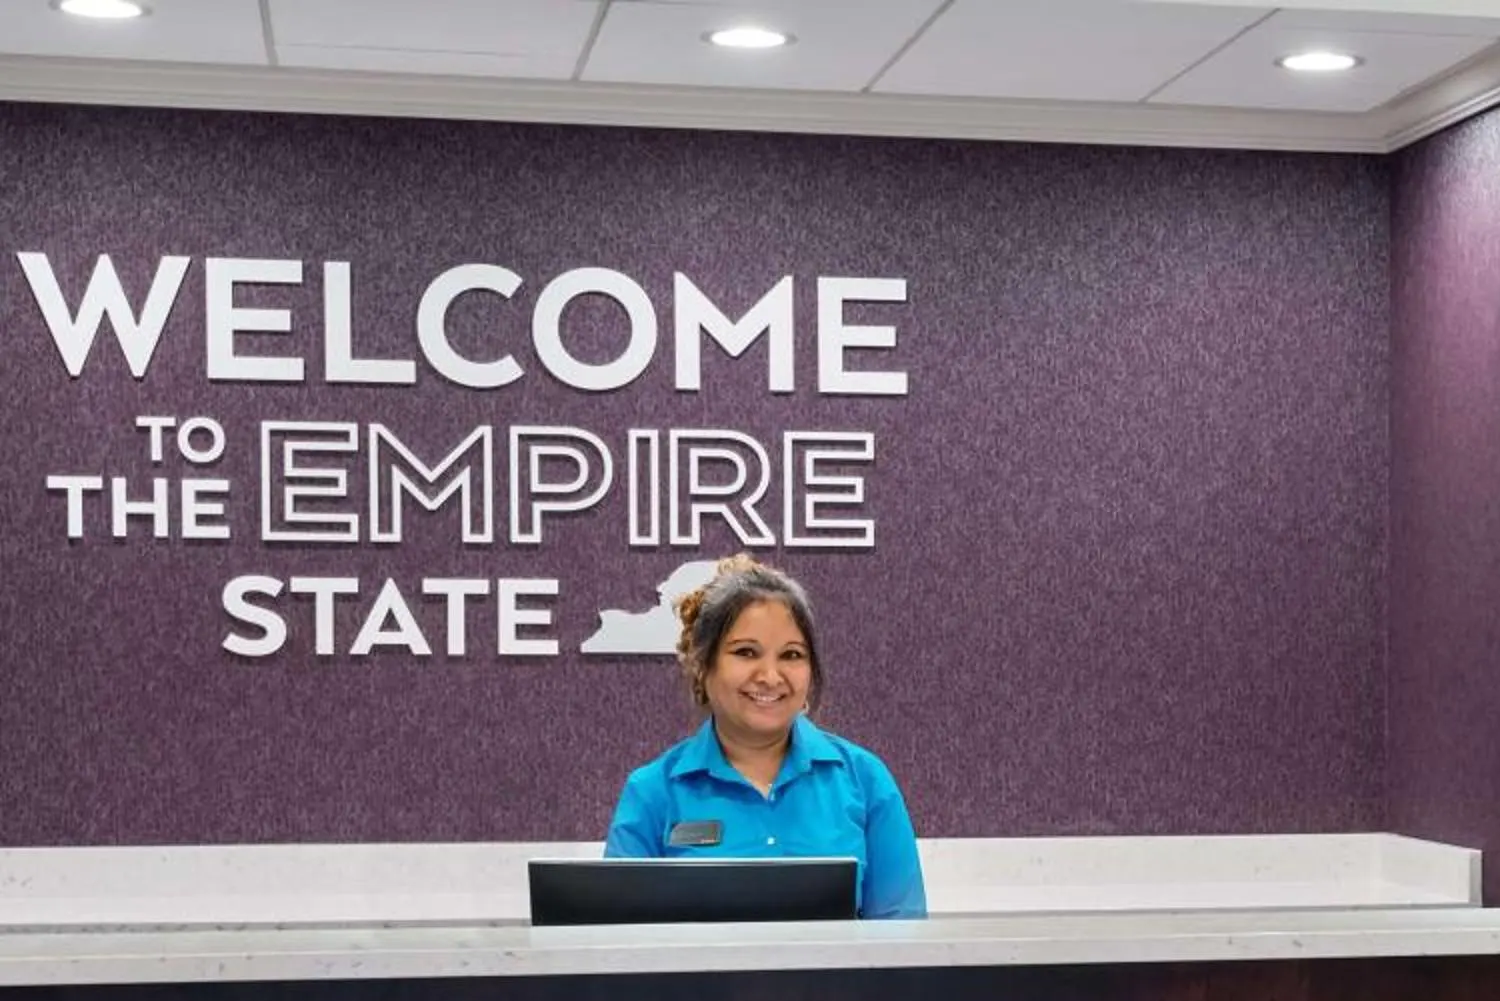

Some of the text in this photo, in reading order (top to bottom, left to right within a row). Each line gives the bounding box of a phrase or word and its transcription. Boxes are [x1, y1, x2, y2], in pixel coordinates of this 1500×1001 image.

[16, 251, 909, 395] WELCOME
[136, 416, 225, 462] TO
[47, 475, 231, 539] THE
[260, 419, 875, 547] EMPIRE
[221, 575, 560, 657] STATE
